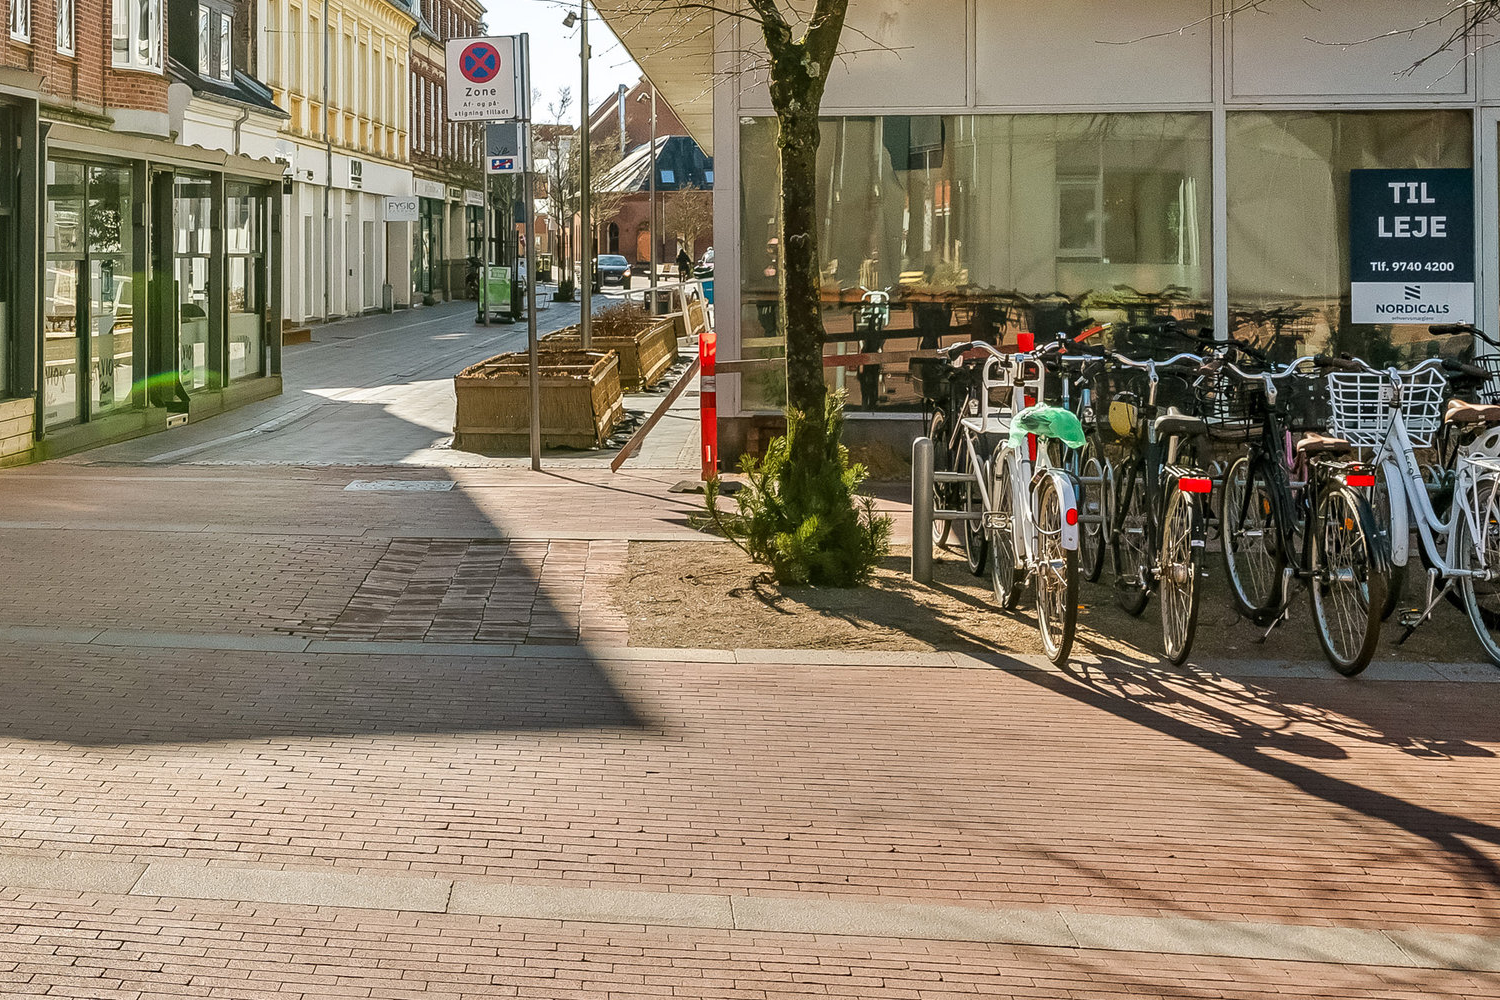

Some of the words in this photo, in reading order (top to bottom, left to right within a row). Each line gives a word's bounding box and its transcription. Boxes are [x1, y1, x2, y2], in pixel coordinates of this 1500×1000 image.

[465, 87, 497, 97] Zone
[1388, 182, 1435, 204] TIL
[388, 202, 416, 210] FYSIO
[1378, 216, 1447, 238] LEJE
[1370, 261, 1389, 271] Tlf.
[1392, 261, 1422, 271] 9740
[1424, 261, 1454, 271] 4200
[1375, 304, 1450, 313] NORDICALS
